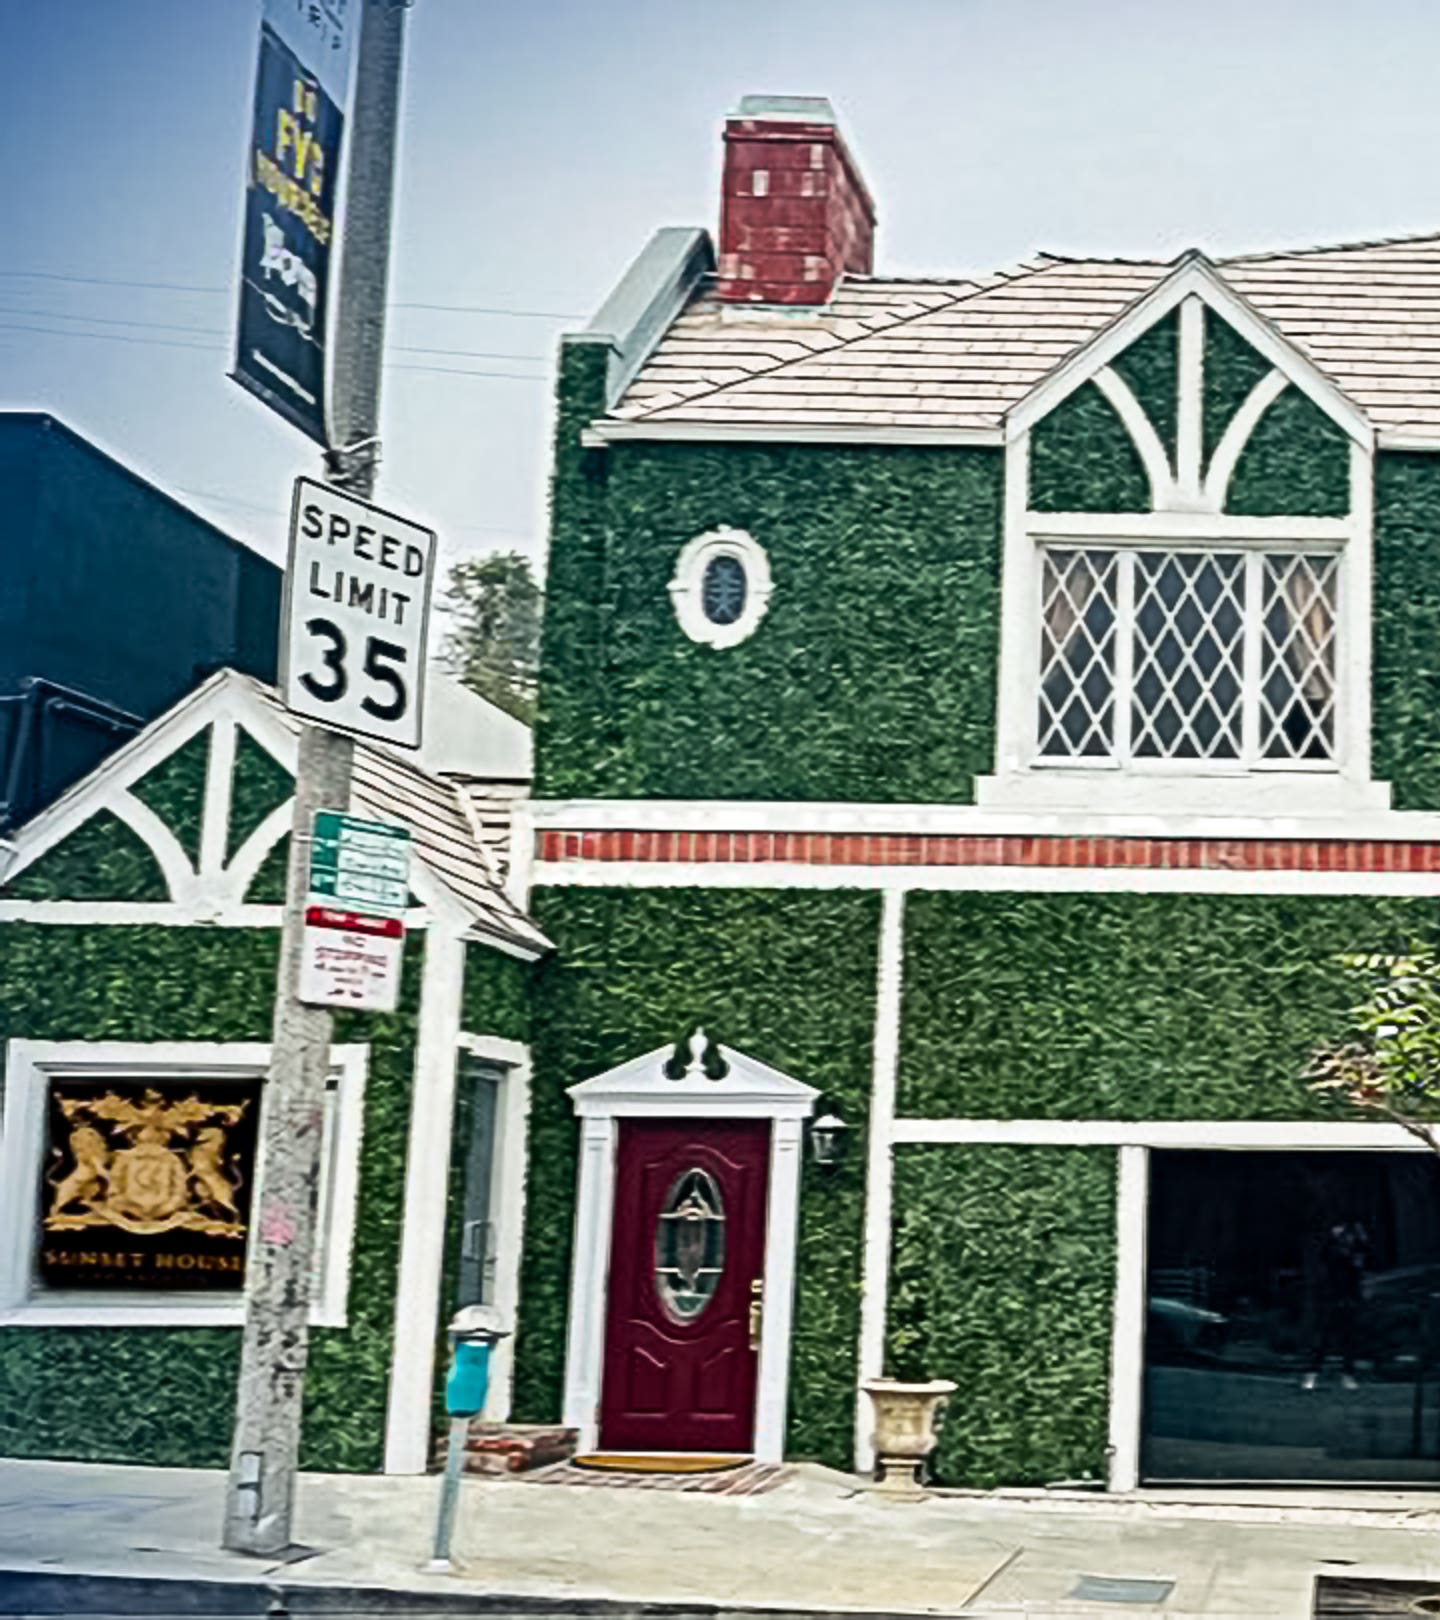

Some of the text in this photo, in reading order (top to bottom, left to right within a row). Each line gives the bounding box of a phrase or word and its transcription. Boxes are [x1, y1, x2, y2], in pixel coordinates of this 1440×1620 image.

[301, 504, 424, 577] SPEED
[310, 560, 411, 625] LIMIT
[298, 617, 408, 722] 35
[46, 1250, 143, 1267] SUNSET
